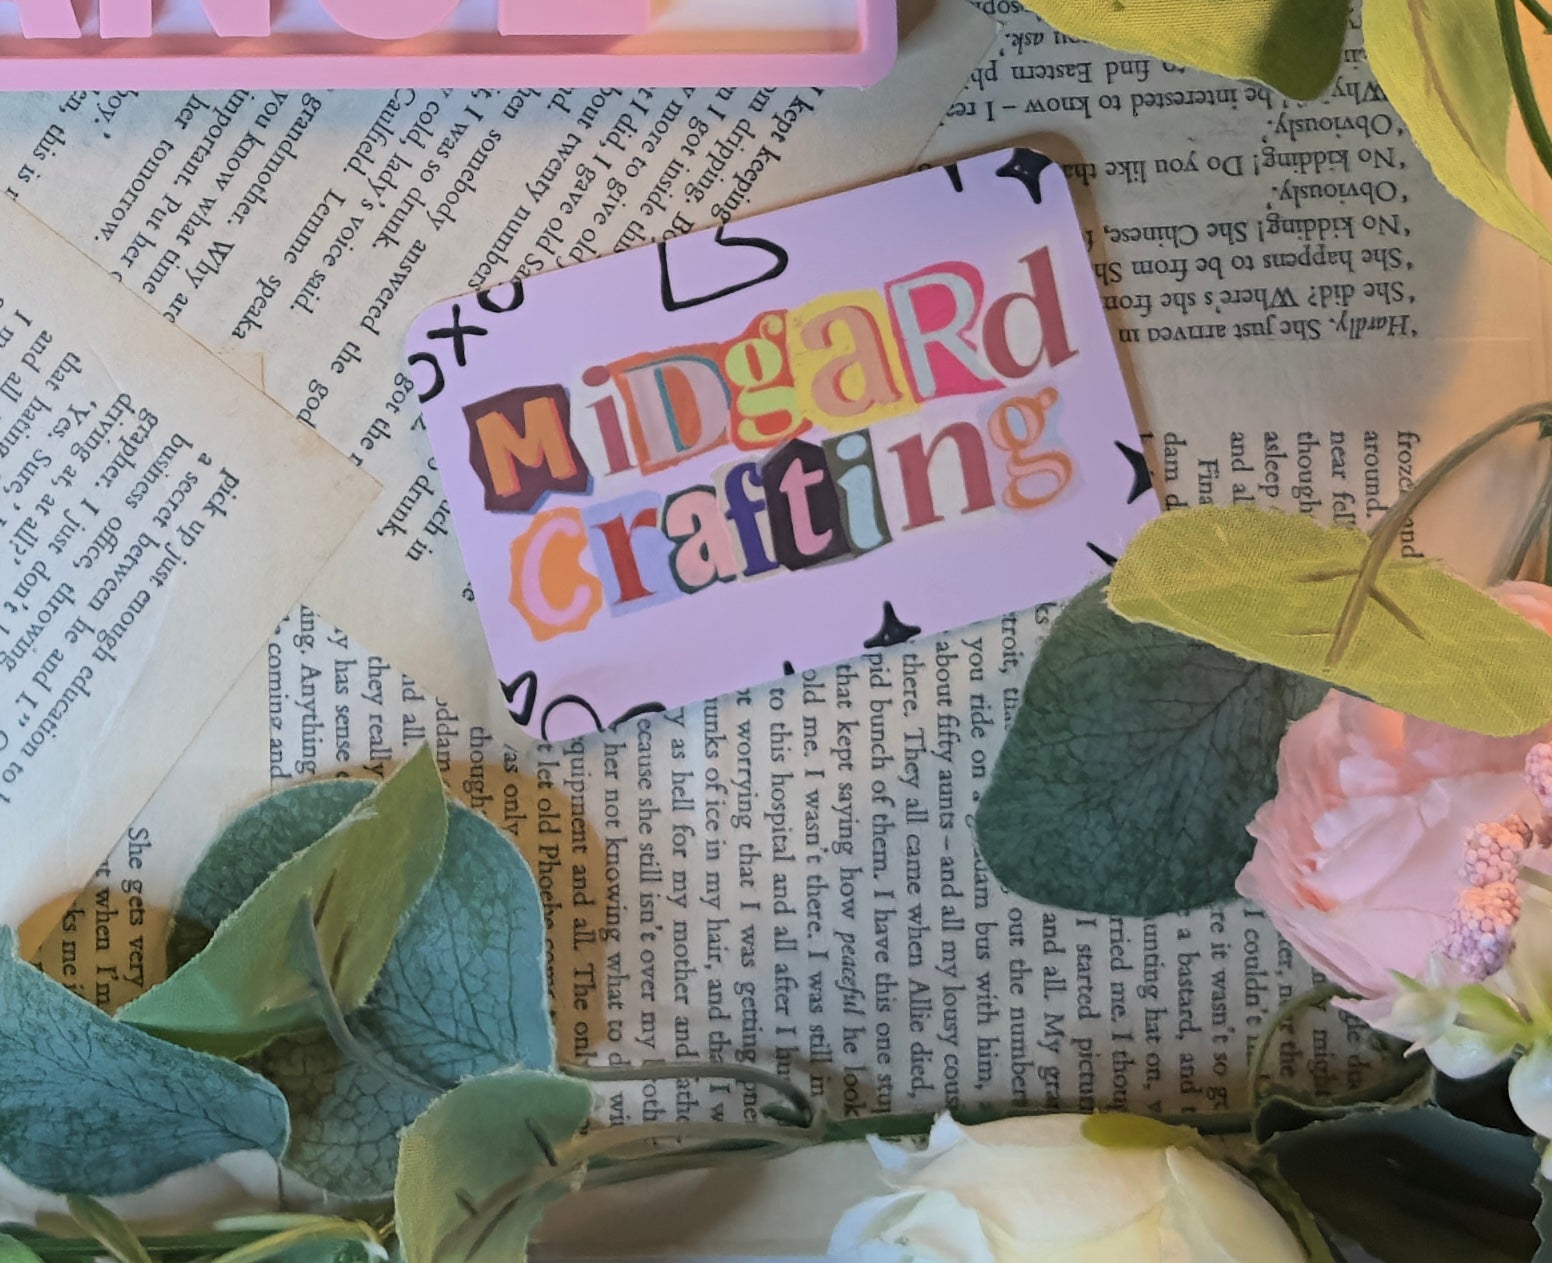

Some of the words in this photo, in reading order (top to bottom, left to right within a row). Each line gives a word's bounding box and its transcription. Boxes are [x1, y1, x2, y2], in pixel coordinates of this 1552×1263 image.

[424, 127, 503, 233] somebody
[683, 117, 757, 205] dripping.
[1104, 159, 1148, 185] like
[1153, 148, 1200, 174] you
[1205, 153, 1245, 178] Do
[1252, 139, 1351, 177] kidding!
[92, 138, 176, 243] tomorrow.
[282, 186, 348, 266] Lemme
[321, 215, 366, 268] voice
[1102, 223, 1200, 249] Chinese,
[1205, 220, 1249, 246] She
[1255, 211, 1355, 244] kidding!
[1130, 257, 1190, 284] from
[1194, 255, 1225, 281] be
[1229, 254, 1256, 272] to
[1261, 242, 1356, 274] happens
[230, 273, 283, 340] speaka
[288, 267, 327, 316] said.
[358, 237, 428, 337] answered
[1159, 291, 1197, 317] she
[1202, 285, 1301, 315] Where's
[1306, 282, 1356, 309] did?
[1231, 313, 1276, 342] just
[1278, 317, 1322, 342] She
[329, 339, 363, 376] the
[1162, 430, 1189, 484] dam
[1229, 430, 1256, 473] and
[1256, 430, 1289, 499] asleep
[1328, 429, 1347, 481] near
[1362, 428, 1390, 519] around.
[200, 465, 241, 518] pick
[174, 518, 207, 548] up
[147, 540, 188, 589] just
[90, 588, 152, 664] enough
[834, 662, 861, 710] that
[859, 652, 894, 690] pid
[18, 664, 95, 759] education
[868, 697, 895, 772] bunch
[828, 718, 861, 773] kept
[0, 760, 25, 785] to
[869, 778, 897, 809] of
[829, 781, 861, 856] saying
[126, 825, 153, 870] She
[870, 812, 897, 881] them.
[119, 878, 146, 927] gets
[838, 865, 865, 921] how
[872, 888, 896, 900] I
[93, 885, 120, 953] when
[872, 907, 899, 964] have
[123, 932, 146, 985] very
[831, 927, 867, 1017] peaceful
[874, 971, 900, 1014] this
[841, 1025, 868, 1055] he
[874, 1020, 893, 1065] one
